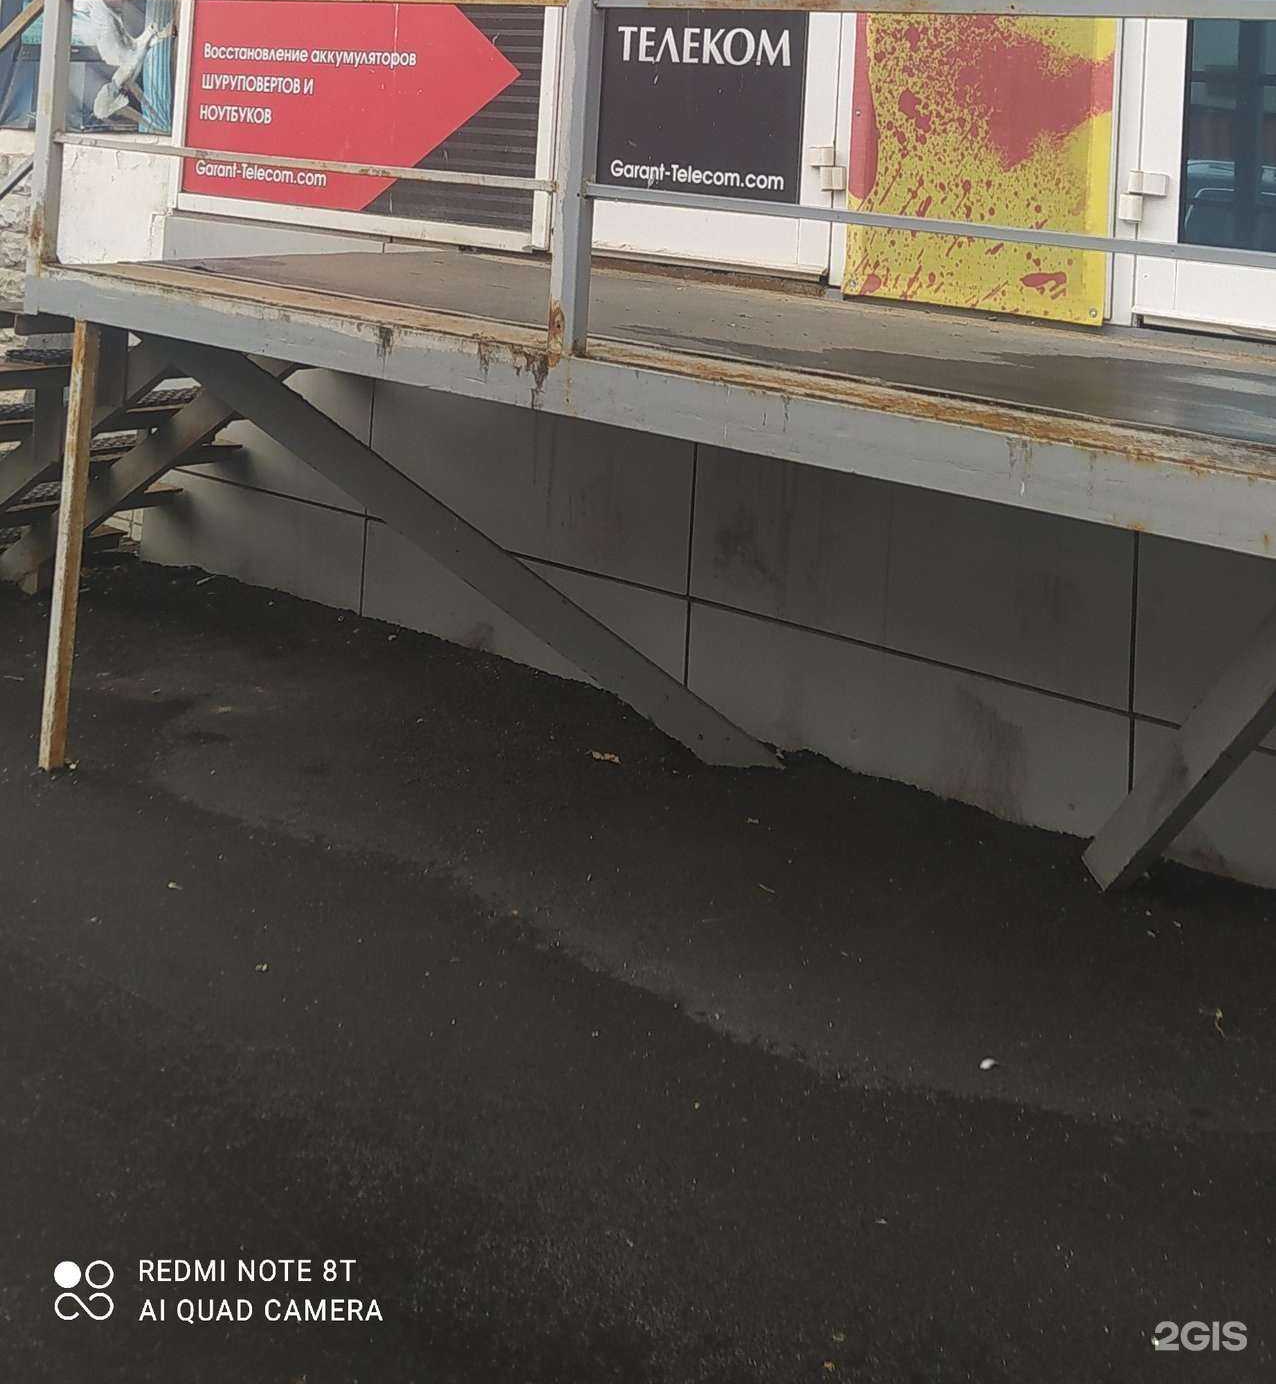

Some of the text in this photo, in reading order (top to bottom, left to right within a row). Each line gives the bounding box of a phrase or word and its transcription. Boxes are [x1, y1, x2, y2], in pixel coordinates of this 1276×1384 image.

[203, 42, 417, 69] Восстановление аккумуляторов
[618, 26, 791, 66] ТЕЛЕКОМ
[202, 74, 314, 95] ШУРУПОВЕРТОВ И
[199, 104, 272, 124] НОУТБУКОВ
[195, 159, 327, 187] Garant-Telecom.com
[610, 159, 785, 191] Garant-Telecom.com
